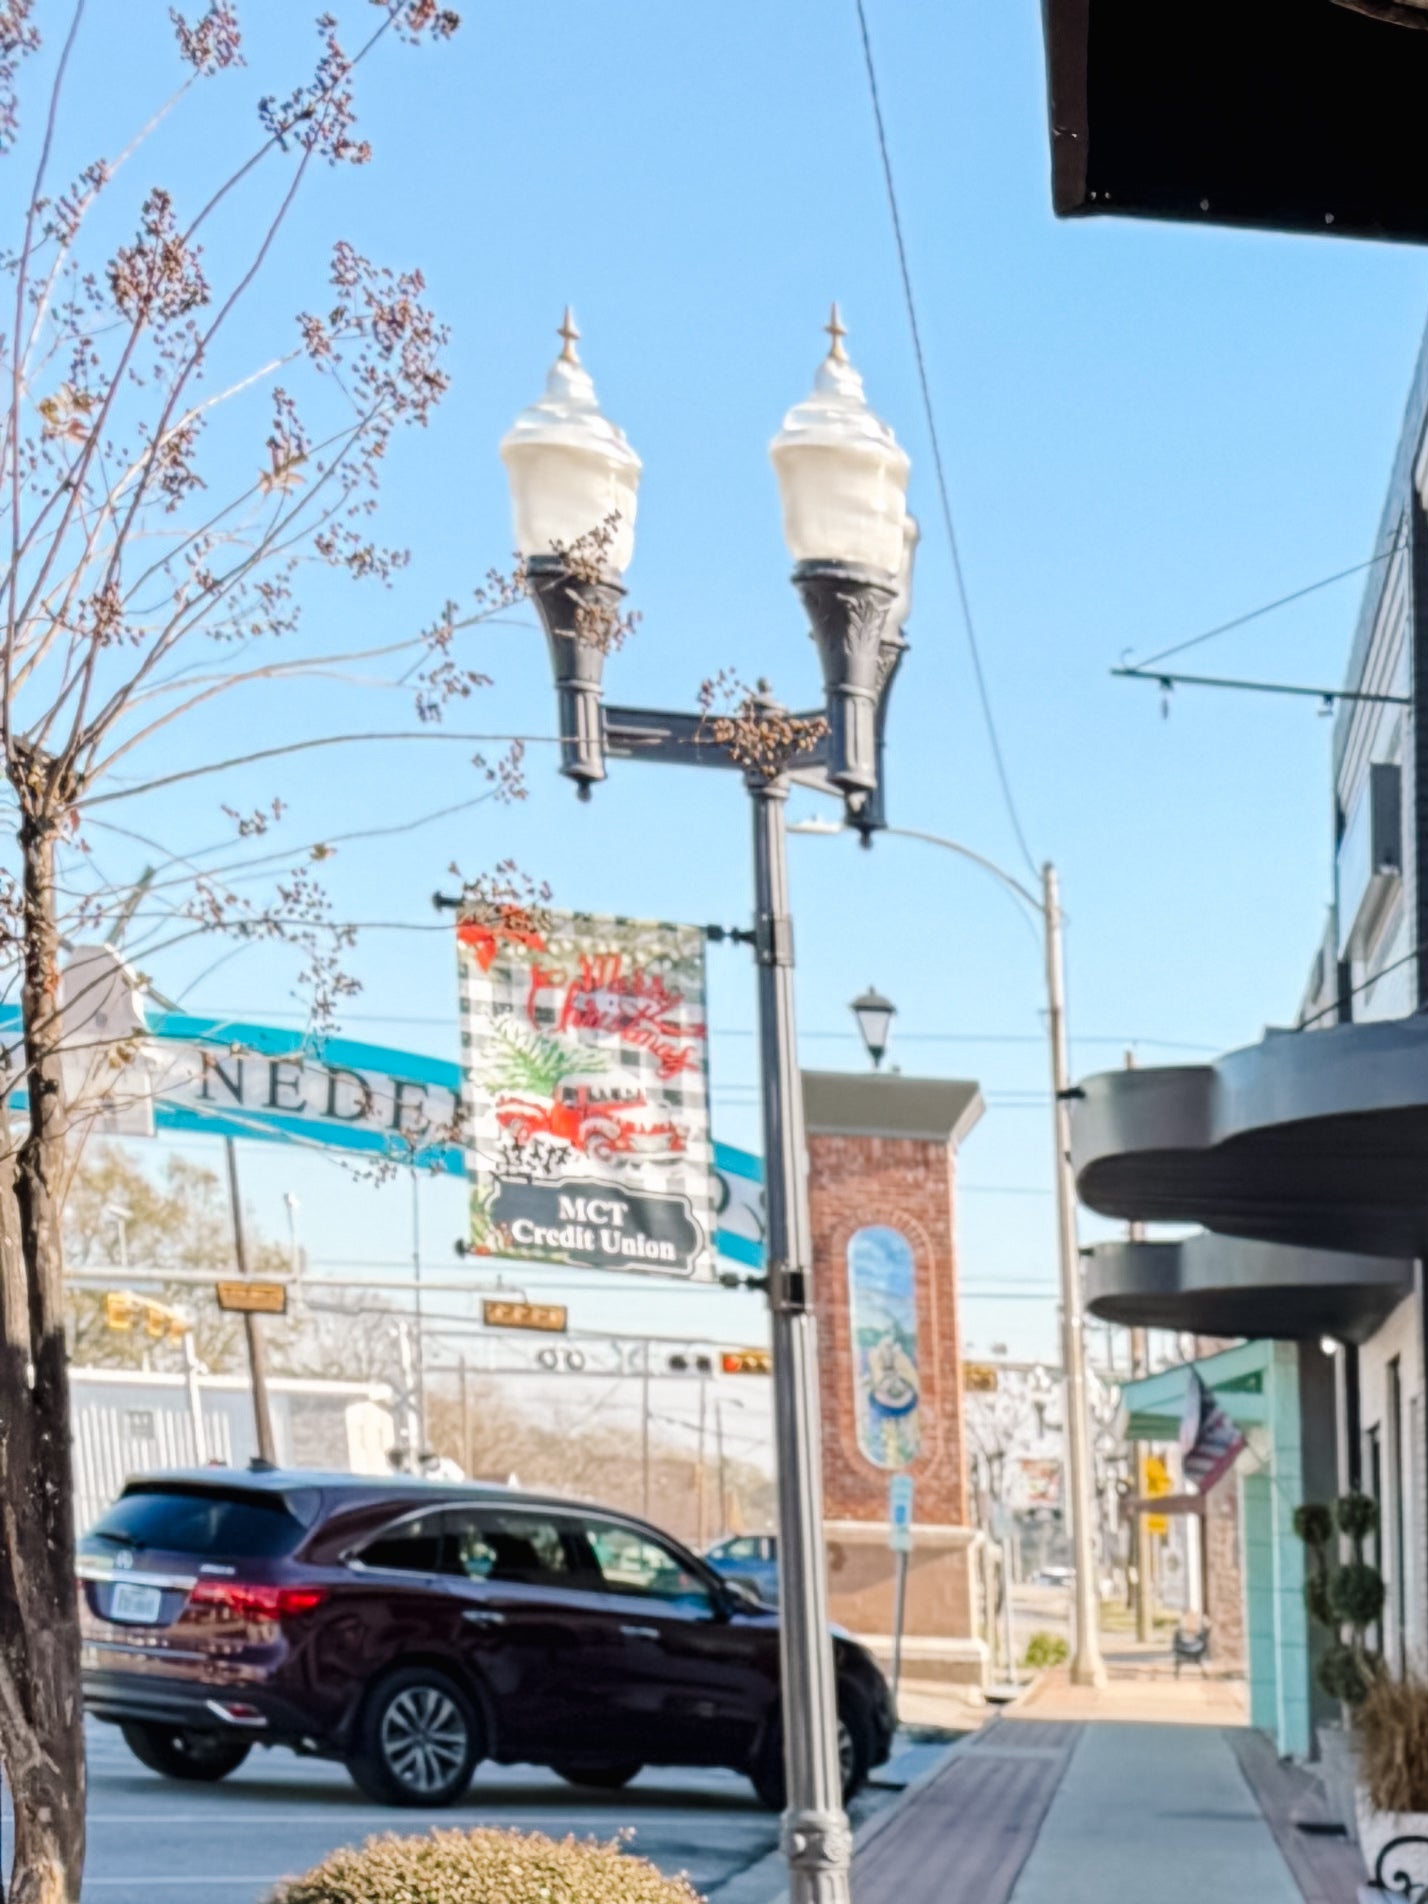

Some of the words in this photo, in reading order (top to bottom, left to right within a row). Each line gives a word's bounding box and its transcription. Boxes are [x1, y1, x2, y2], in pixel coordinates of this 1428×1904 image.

[558, 1195, 629, 1227] MCT
[511, 1218, 595, 1252] Credit
[601, 1229, 678, 1262] Union
